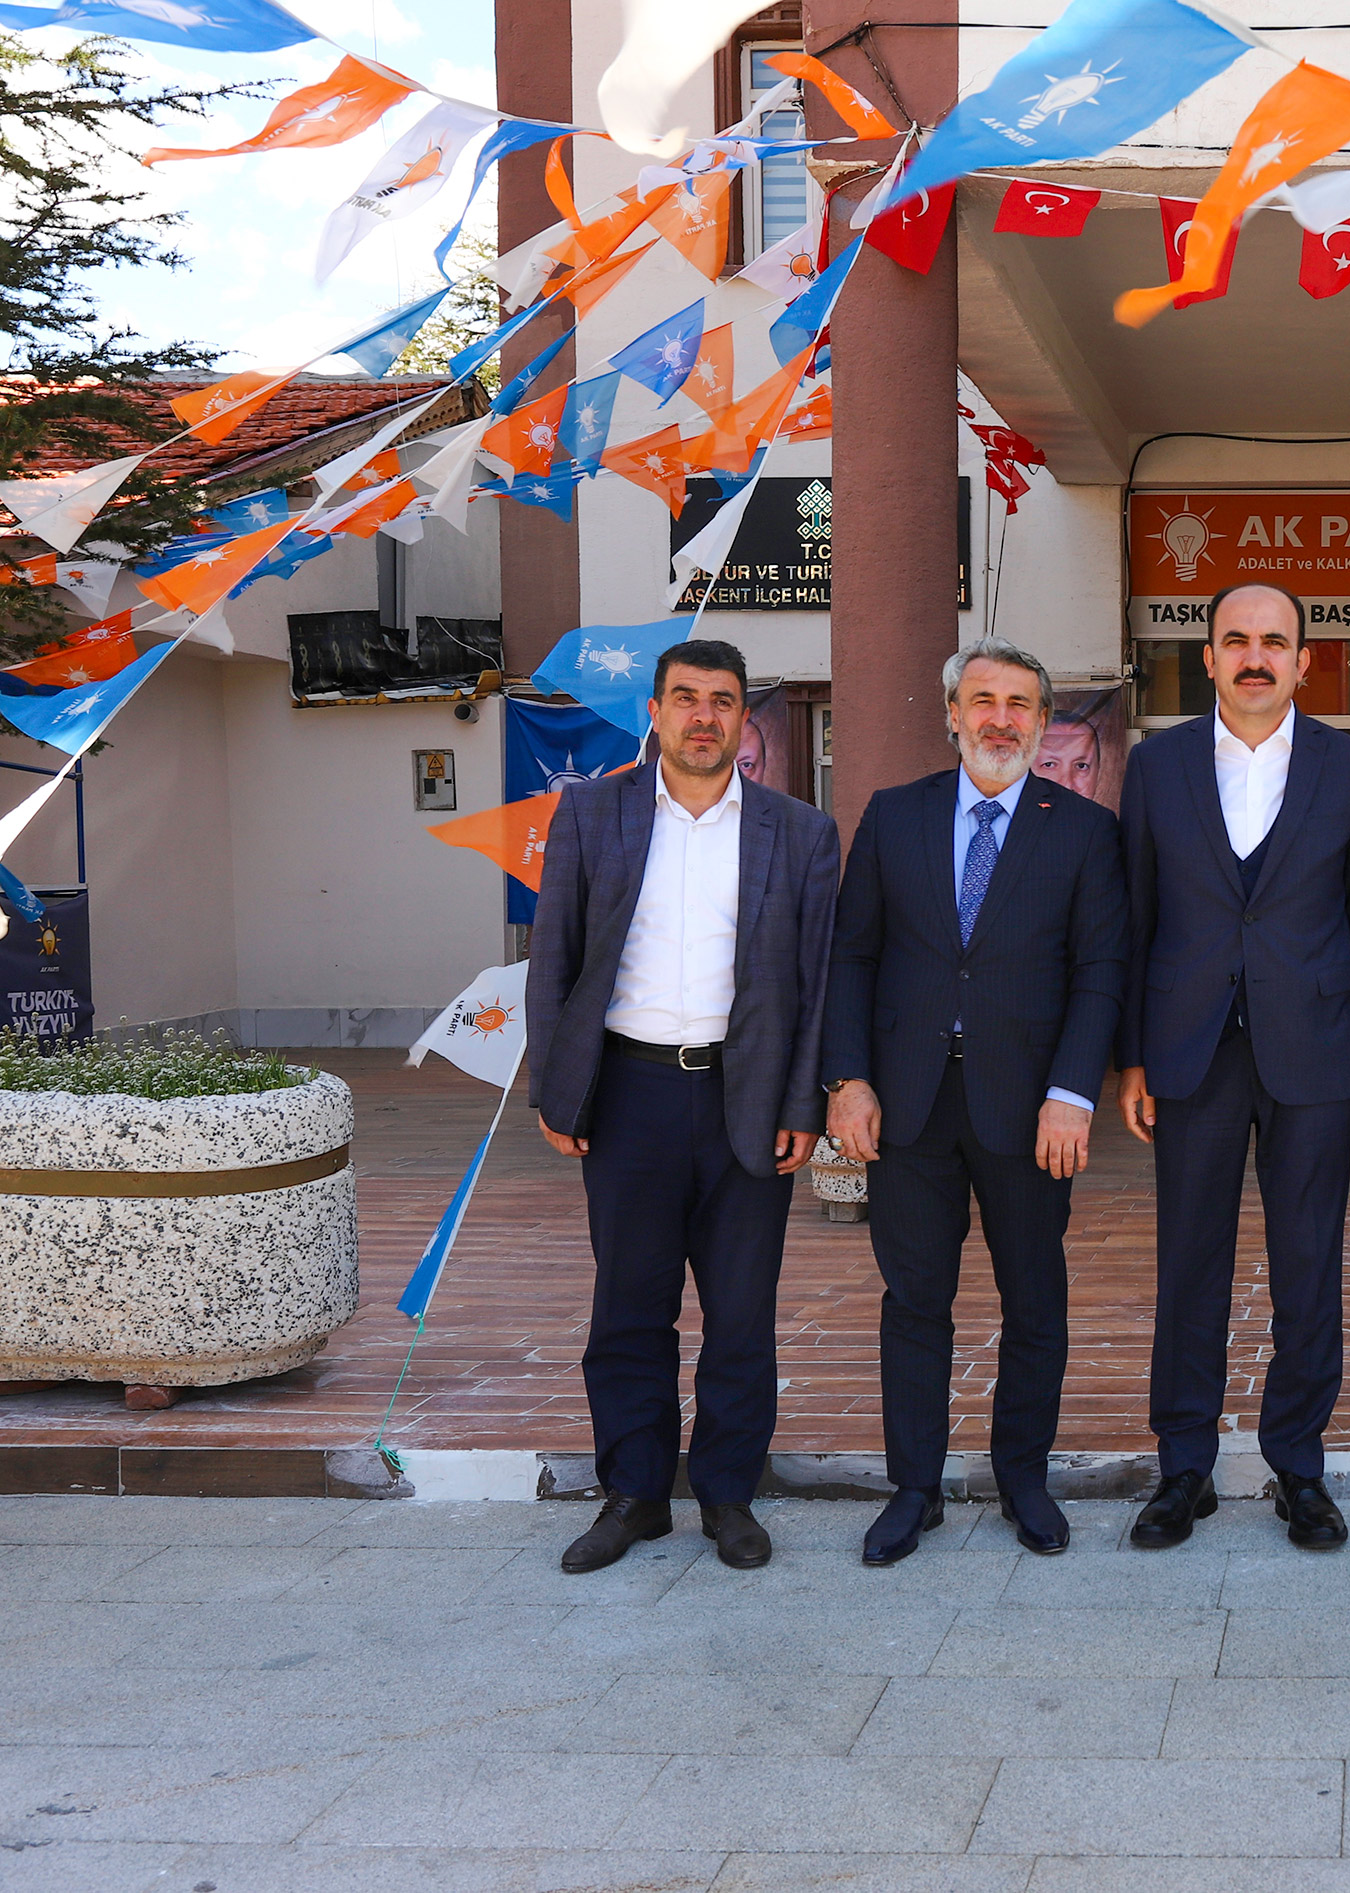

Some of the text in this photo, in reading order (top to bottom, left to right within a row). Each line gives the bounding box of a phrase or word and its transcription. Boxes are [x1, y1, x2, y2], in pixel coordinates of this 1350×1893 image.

[979, 118, 1006, 129] AK
[1237, 516, 1304, 547] AK
[1237, 557, 1293, 570] ADALET
[1297, 560, 1312, 570] ve
[755, 565, 780, 580] VE
[755, 585, 792, 607] İLÇE
[582, 637, 592, 648] AK
[528, 826, 537, 840] AK
